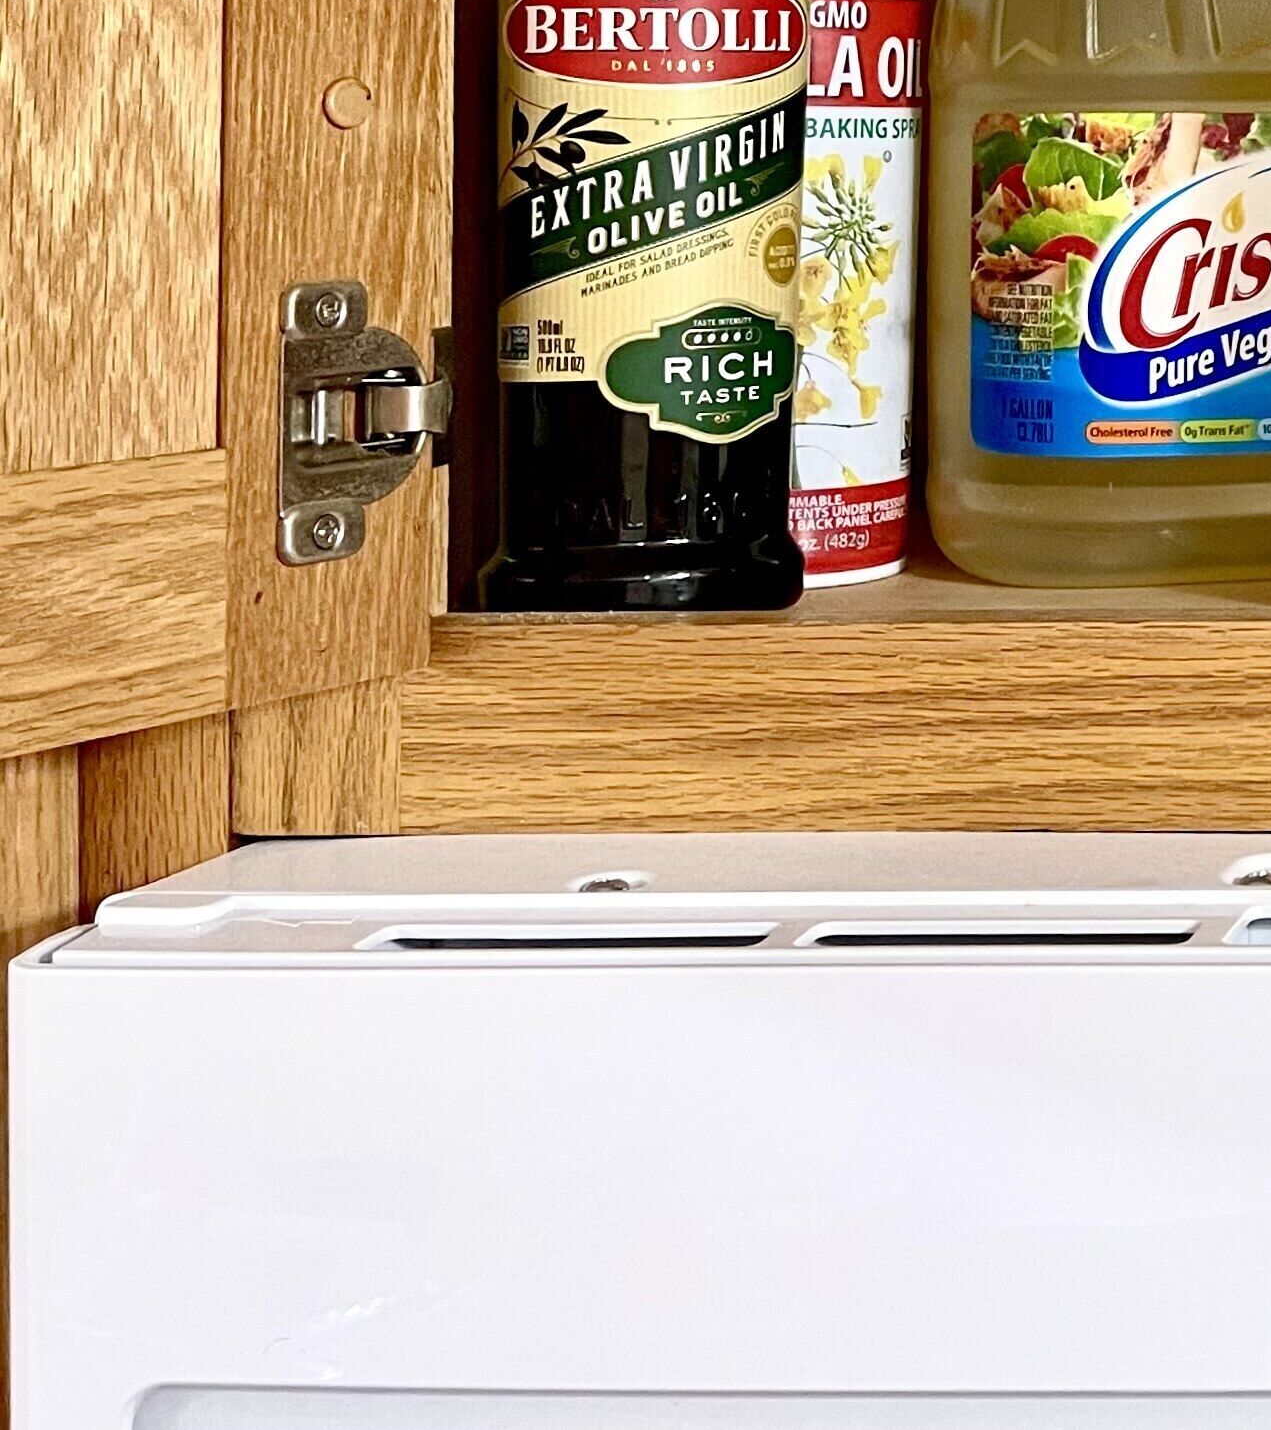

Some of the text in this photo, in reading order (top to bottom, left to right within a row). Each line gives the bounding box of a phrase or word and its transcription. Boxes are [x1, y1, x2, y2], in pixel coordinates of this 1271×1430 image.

[524, 4, 791, 55] BERTOLLI
[611, 59, 651, 72] DAL
[878, 36, 922, 98] OIL
[806, 117, 888, 139] BAKING
[531, 110, 785, 239] EXTRA VIRGIN
[587, 181, 743, 255] OLIVE OIL
[580, 237, 735, 298] MARINADES AND BREAD DIPPING
[585, 266, 614, 283] IDEAL
[618, 258, 636, 272] FOR
[640, 248, 673, 266] SALAD
[1041, 298, 1052, 310] FAT
[1041, 312, 1052, 324] FAT
[664, 350, 773, 383] RICH
[1149, 351, 1214, 395] Pure
[680, 385, 760, 405] TASTE
[1009, 397, 1053, 419] GALLON
[1090, 425, 1173, 438] Cholesterol Free
[1184, 426, 1197, 439] 0g
[1199, 425, 1226, 436] Trans
[832, 501, 873, 517] UNDER
[797, 517, 834, 531] BACK
[836, 513, 872, 528] PANEL
[824, 529, 870, 552] (482g)
